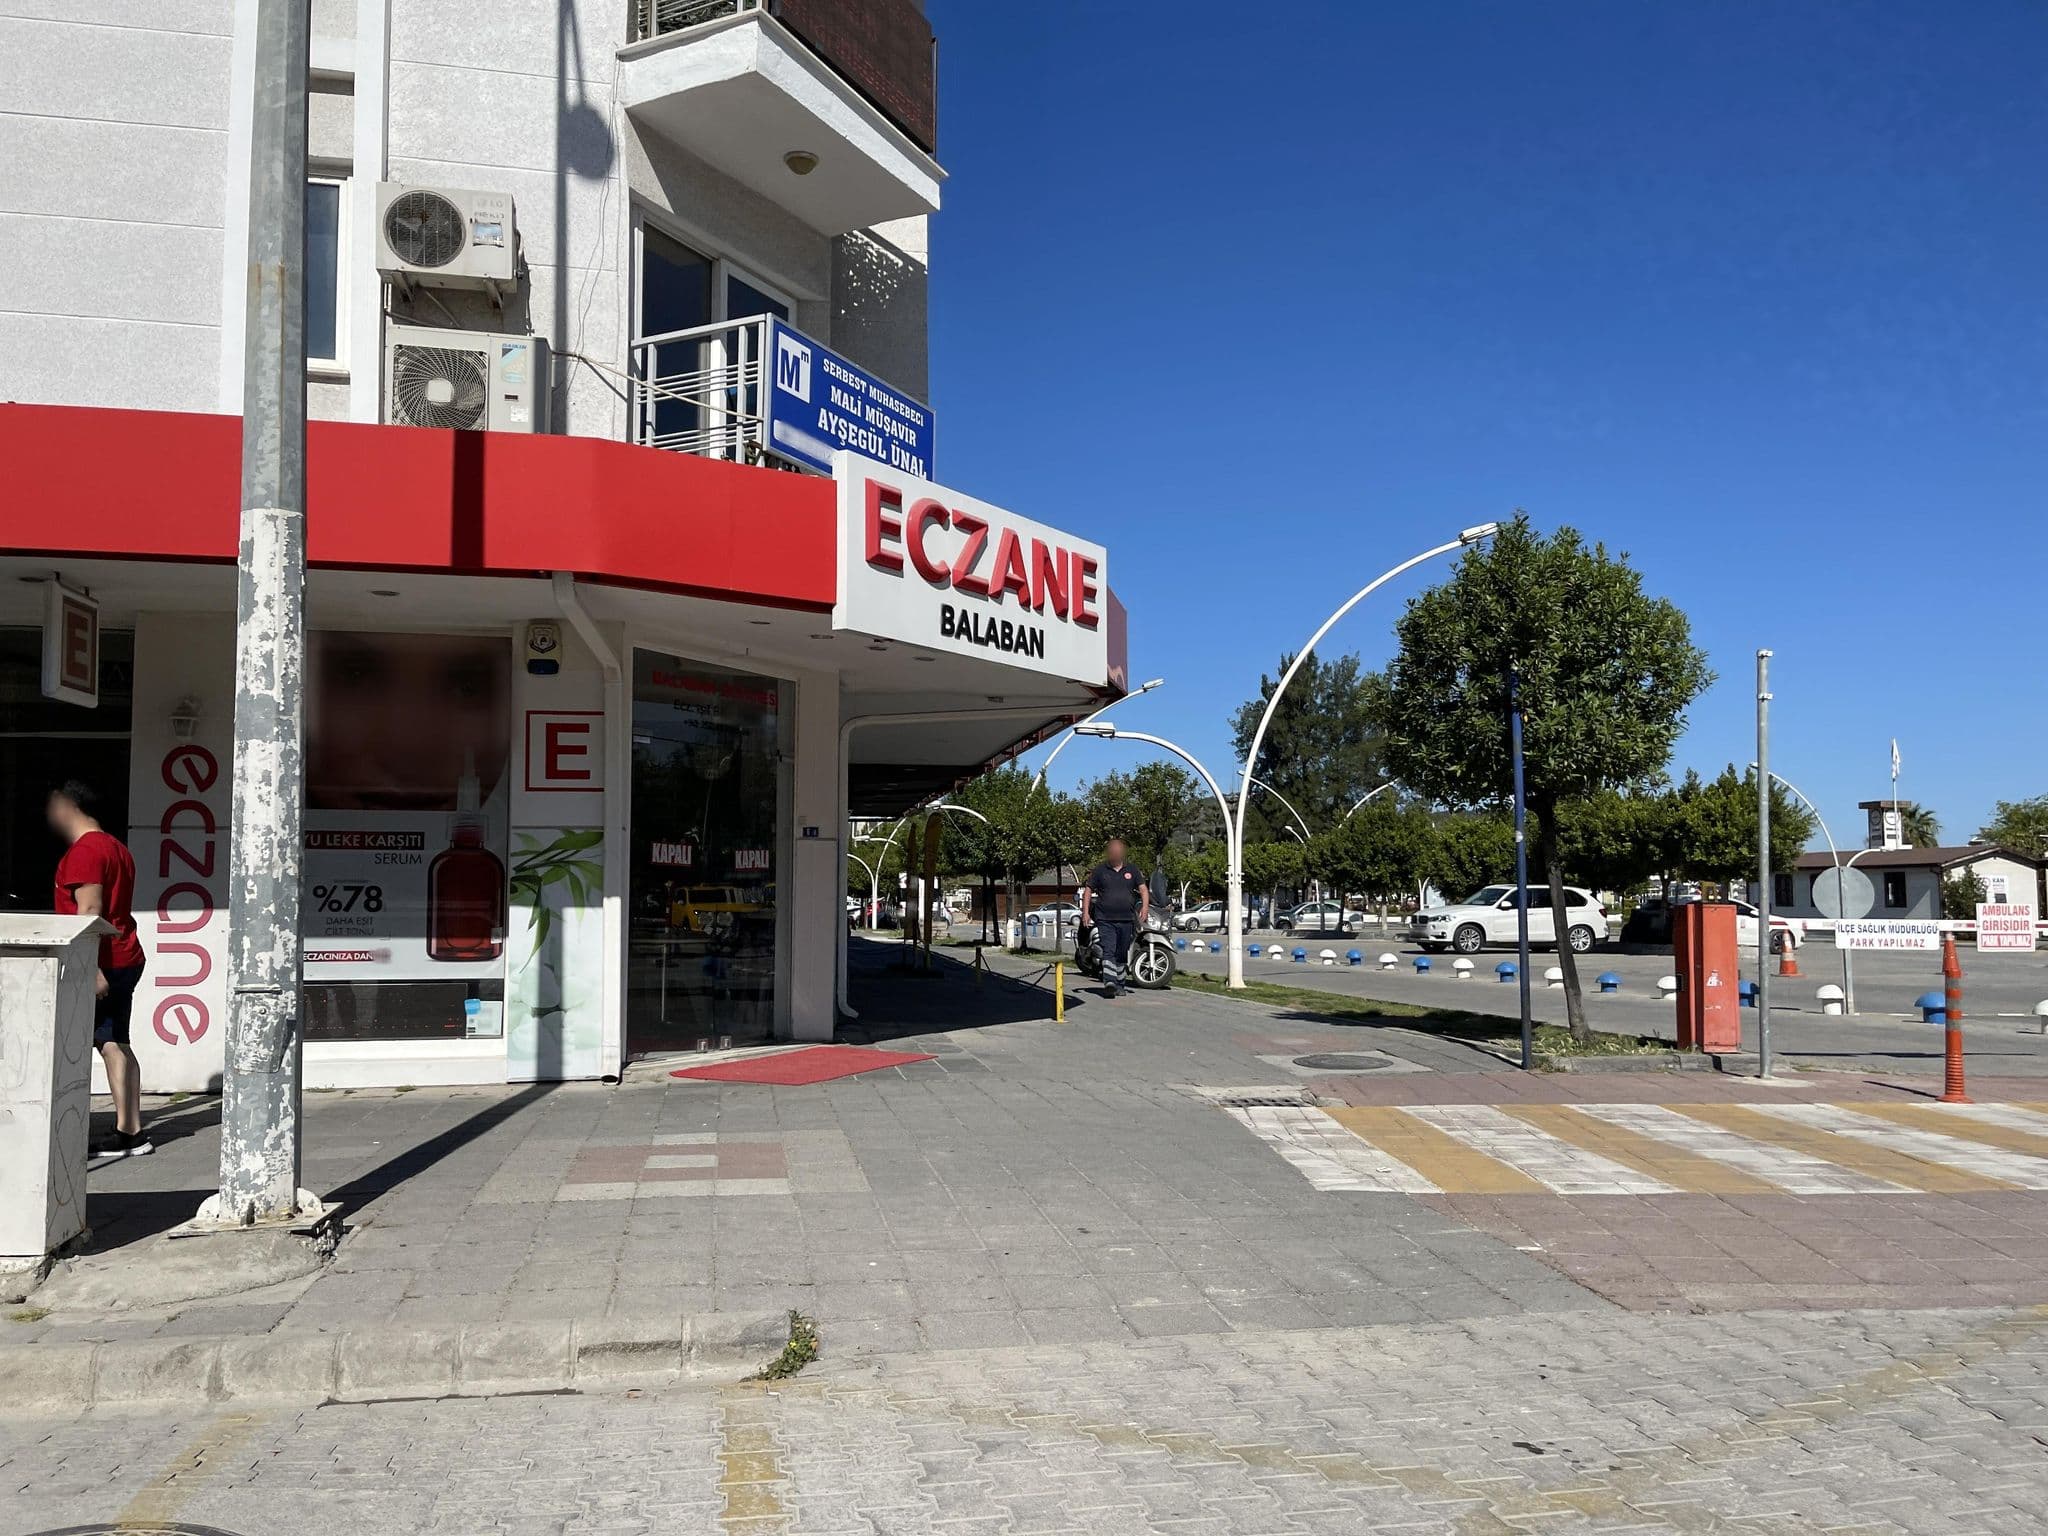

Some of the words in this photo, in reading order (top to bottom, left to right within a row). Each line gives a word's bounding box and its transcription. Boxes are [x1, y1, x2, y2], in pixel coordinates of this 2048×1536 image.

[823, 358, 867, 394] SERBEST
[831, 385, 862, 418] MALİ
[865, 404, 917, 448] MÜŞAVİR
[818, 407, 887, 460] AYŞEGÜL
[891, 440, 927, 481] ÜNAL
[865, 477, 1099, 629] ECZANE
[66, 611, 90, 679] E
[940, 603, 1045, 659] BALABAN
[545, 723, 591, 780] E
[326, 833, 361, 847] LEKE
[652, 842, 692, 865] KAPALI
[374, 852, 422, 865] SERUM
[735, 849, 769, 869] KAPALI
[152, 744, 219, 1047] eczane
[313, 885, 382, 913] %78
[326, 916, 354, 925] DAHA
[1982, 905, 2031, 916] AMBULANS
[1837, 923, 1856, 935] İLÇE
[1857, 922, 1886, 934] SAĞLIK
[1888, 922, 1938, 935] MÜDÜRLÜĞÜ
[1850, 938, 1874, 948] PARK
[1878, 938, 1925, 948] YAPILMAZ
